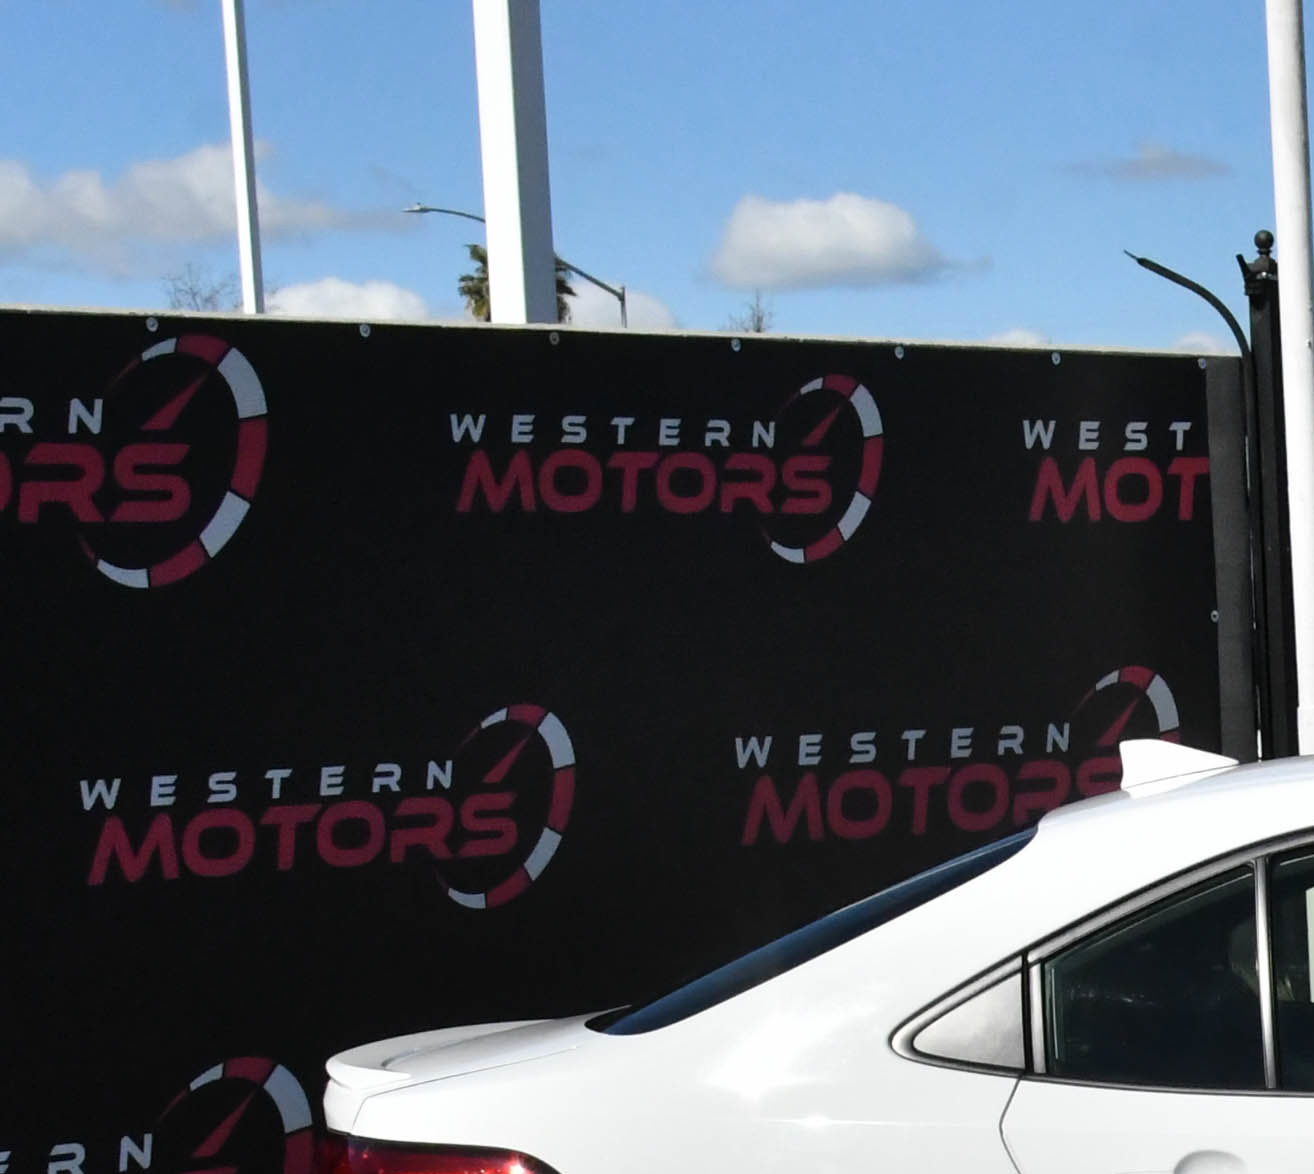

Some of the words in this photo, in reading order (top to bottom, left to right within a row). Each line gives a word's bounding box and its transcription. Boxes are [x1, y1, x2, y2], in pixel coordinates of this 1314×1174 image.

[450, 414, 776, 448] WESTERN
[1022, 419, 1192, 451] WEST
[0, 442, 191, 523] RS
[456, 448, 833, 515] MOTORS
[1029, 455, 1211, 523] MOT
[735, 722, 1070, 769] WESTERN
[79, 760, 453, 811] WESTERN
[87, 791, 518, 886] MOTORS
